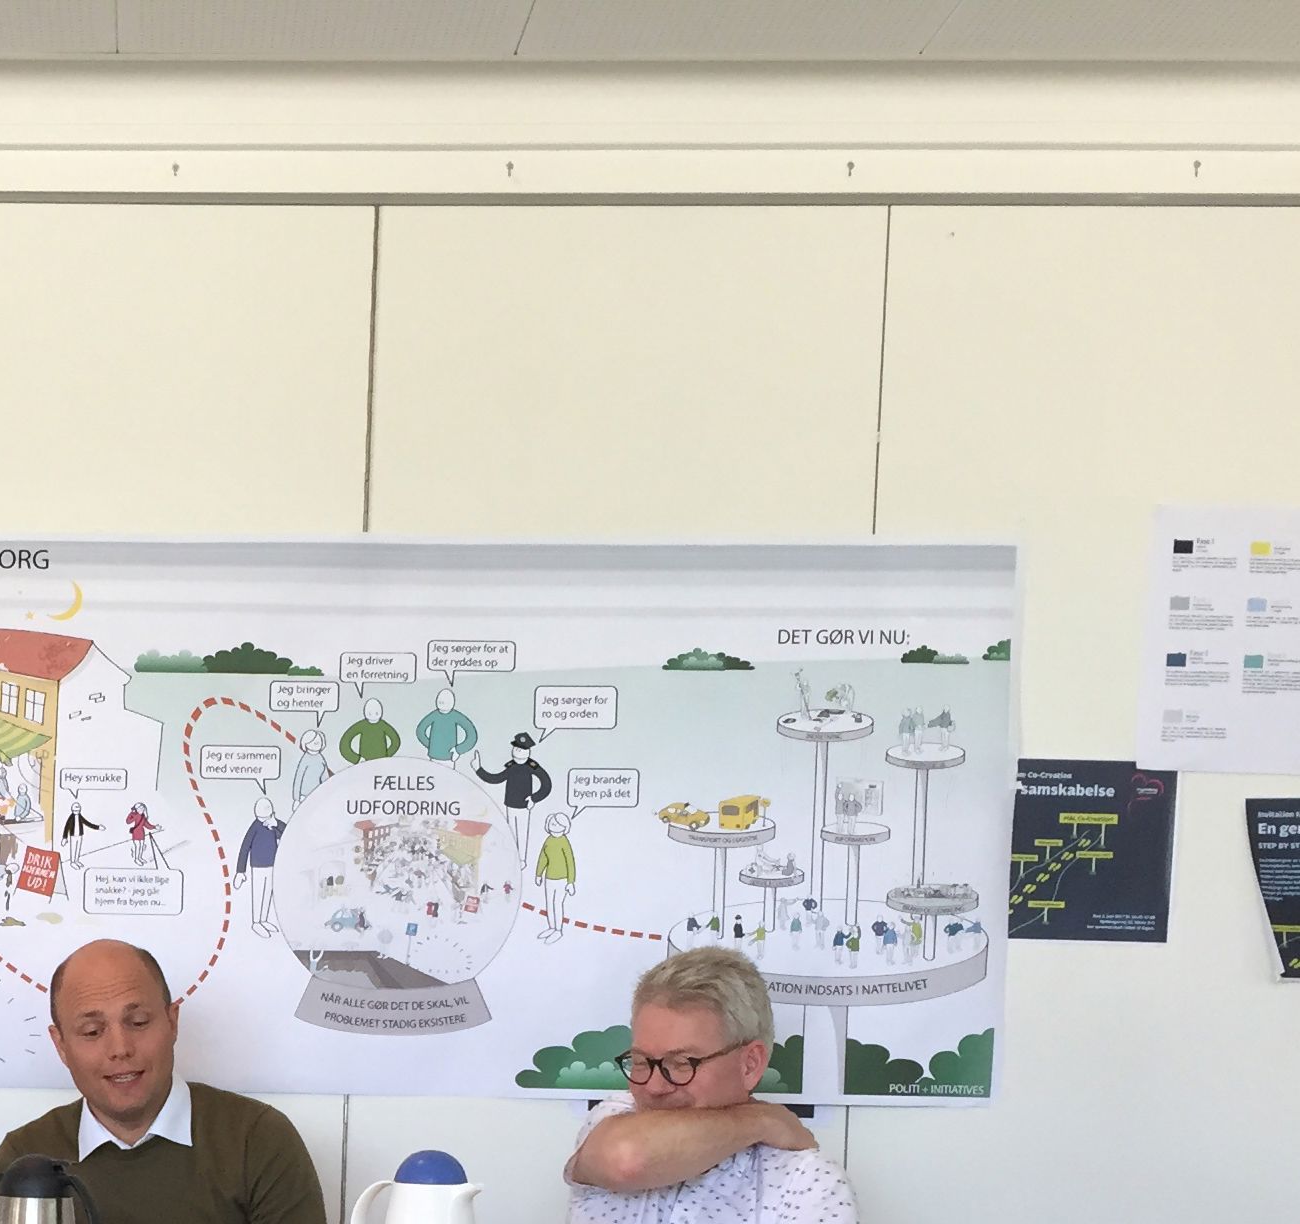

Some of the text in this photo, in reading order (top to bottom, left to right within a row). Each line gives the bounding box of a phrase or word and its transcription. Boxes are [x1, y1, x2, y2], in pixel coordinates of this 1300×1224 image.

[777, 628, 911, 646] DET GØR VI NU:
[432, 643, 509, 655] Jeg sørger for at
[347, 656, 394, 668] Jeg driver
[431, 658, 499, 670] der ryddes op
[346, 669, 409, 682] en forretning
[276, 685, 332, 697] Jeg bringer
[276, 697, 324, 709] og henter
[541, 695, 609, 708] Jeg sørger for
[541, 709, 599, 721] ro og orden
[205, 750, 277, 762] Jeg er sammen
[205, 763, 263, 774] med venner
[64, 772, 122, 785] Hey smukke
[373, 775, 435, 791] FÆLLES
[573, 774, 632, 786] Jeg brander
[573, 788, 631, 800] byen på det
[1020, 783, 1115, 797] samskabelse
[346, 800, 461, 816] UDFORDRING
[1257, 822, 1277, 835] En
[1257, 842, 1300, 850] STEP BY ST
[26, 851, 53, 869] DRIK
[26, 875, 48, 892] UD!
[805, 983, 853, 996] INDSATS
[855, 985, 859, 995] I
[861, 978, 928, 996] NATTELIVET
[320, 992, 341, 1005] NÅR
[343, 998, 365, 1009] ALLE
[367, 1000, 389, 1010] GØR
[390, 1001, 409, 1011] DET
[411, 1000, 425, 1010] DE
[453, 995, 470, 1006] VIL
[324, 1011, 467, 1029] PROBLEMET STADIG EKSISTERE
[888, 1083, 920, 1094] POLITI
[930, 1084, 985, 1095] INITIATIVES
